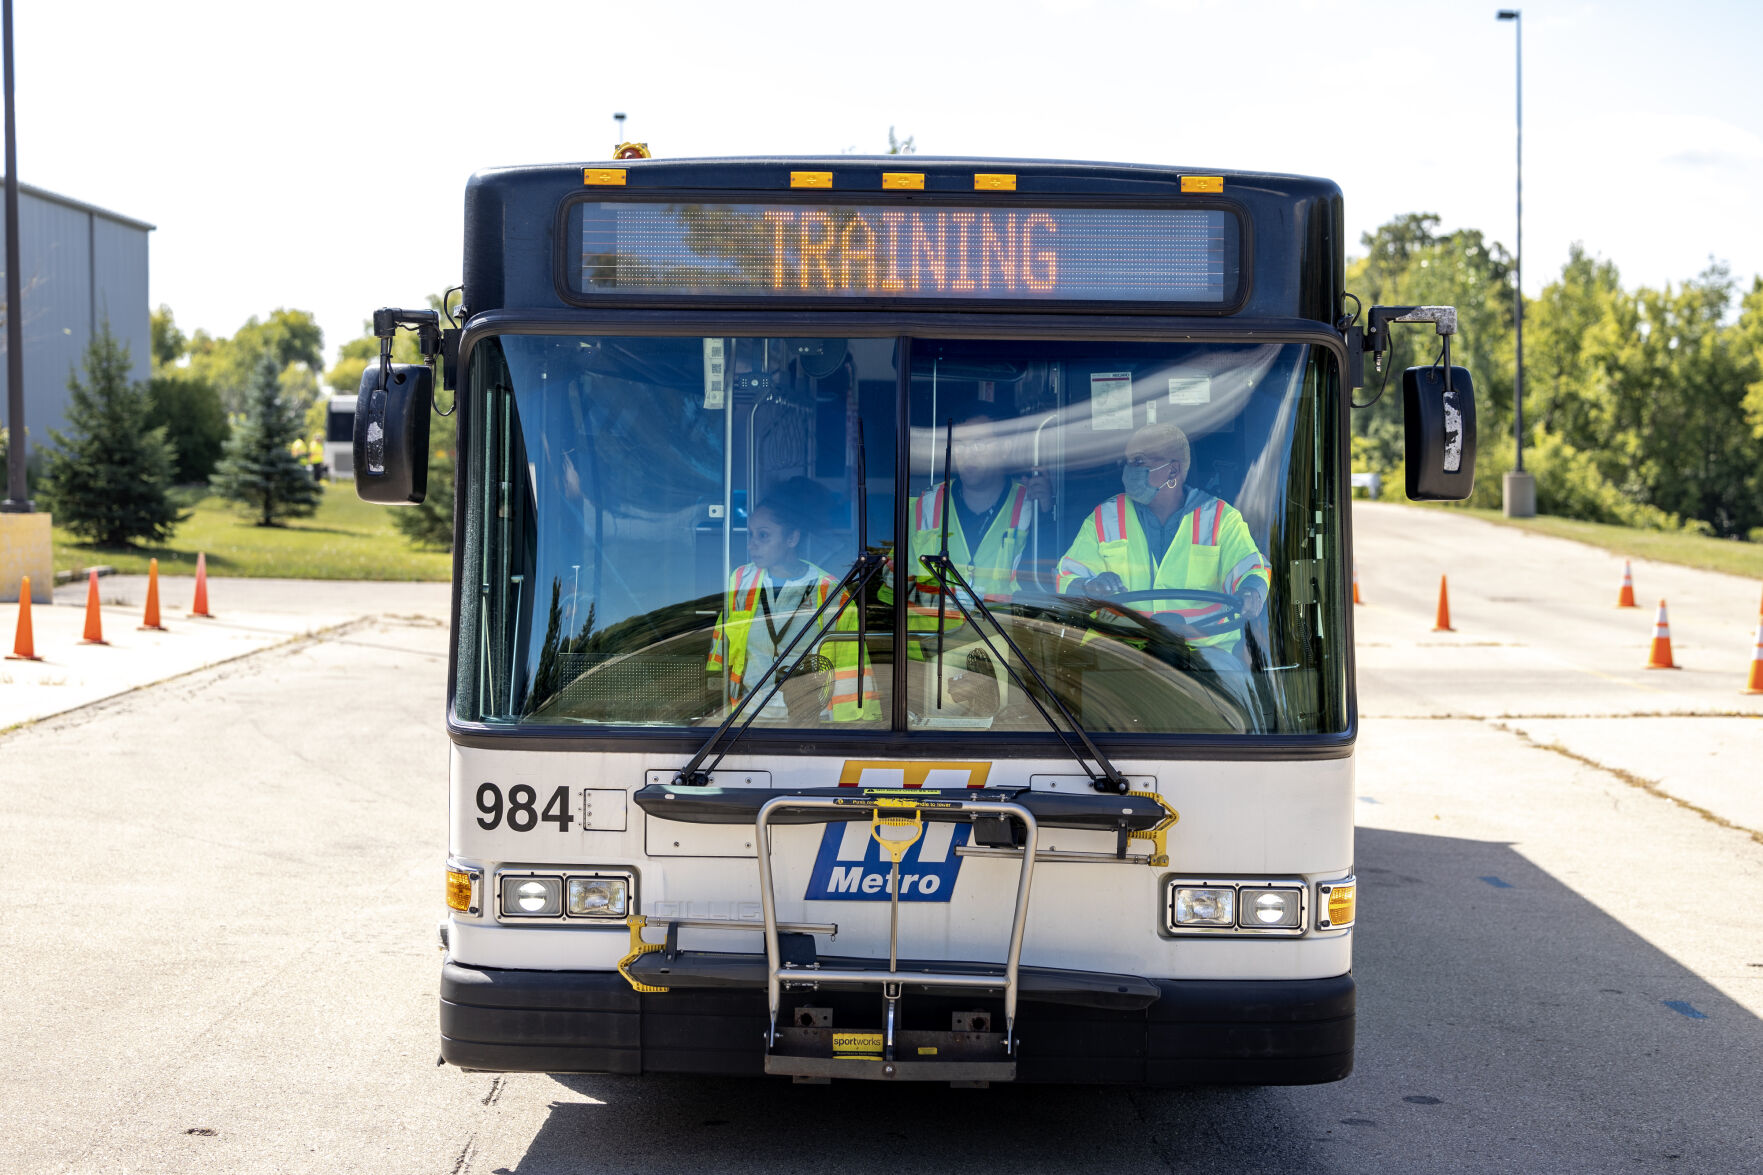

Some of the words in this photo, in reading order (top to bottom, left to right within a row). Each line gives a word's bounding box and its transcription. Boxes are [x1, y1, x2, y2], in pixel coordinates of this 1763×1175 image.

[764, 210, 1057, 290] TRAINING
[476, 782, 574, 832] 984
[826, 866, 941, 895] Metro
[833, 1037, 881, 1046] sportworks
